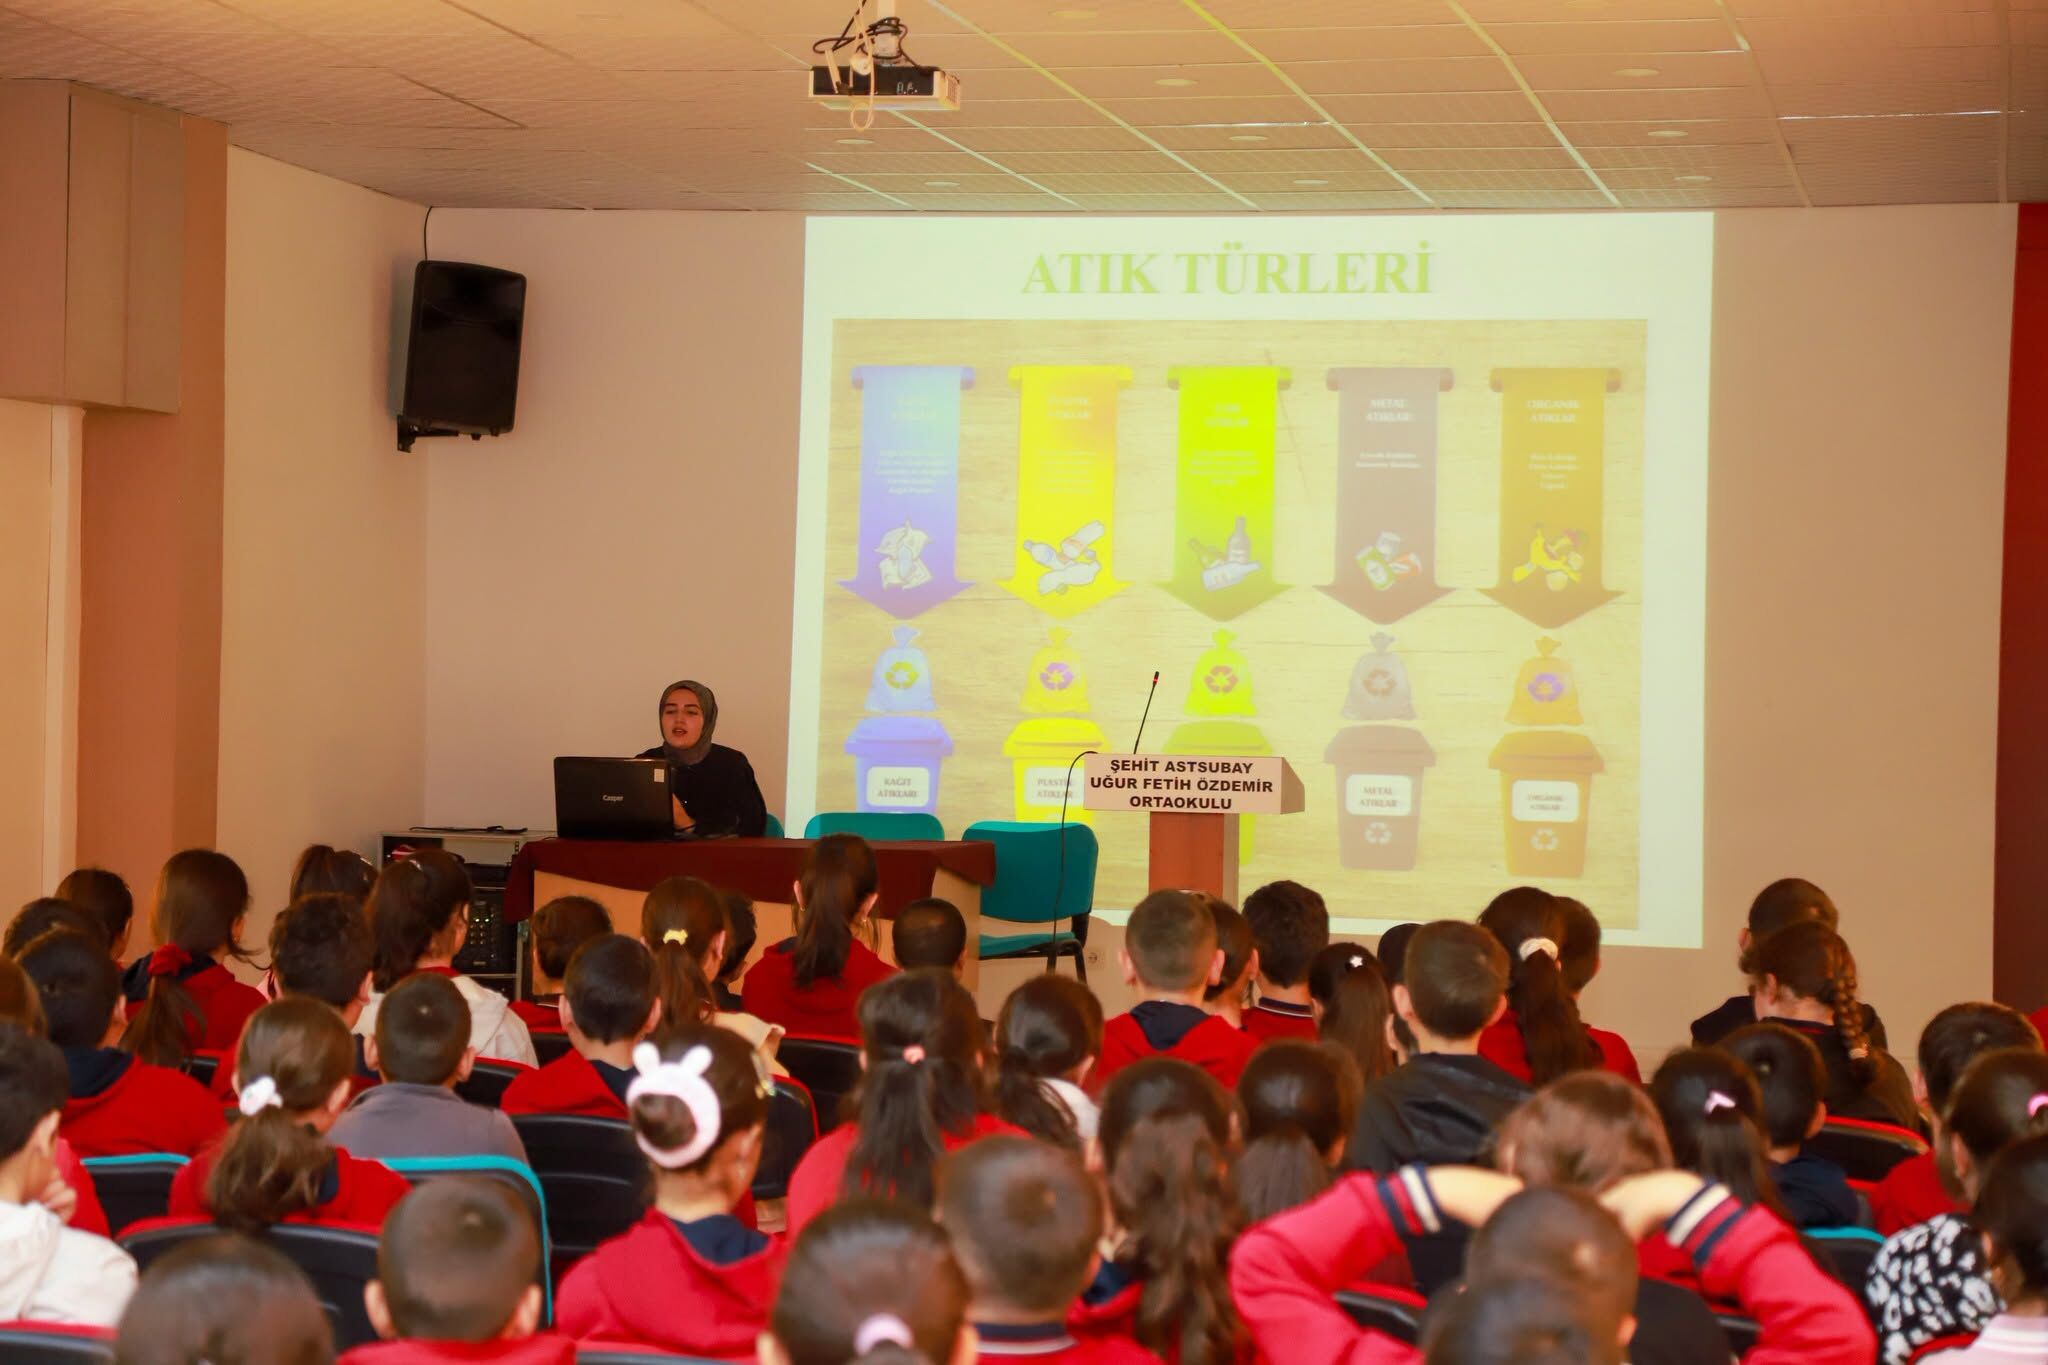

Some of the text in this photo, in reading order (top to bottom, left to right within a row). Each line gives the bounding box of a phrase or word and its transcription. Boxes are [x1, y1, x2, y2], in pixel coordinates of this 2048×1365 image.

[1021, 240, 1436, 295] ATIK TÜRLERİ
[1110, 757, 1254, 774] ŞEHİT ASTSUBAY
[1090, 774, 1273, 793] UĞUR FETİH ÖZDEMİR
[602, 794, 624, 802] Casper
[1129, 796, 1233, 810] ORTAOKULU
